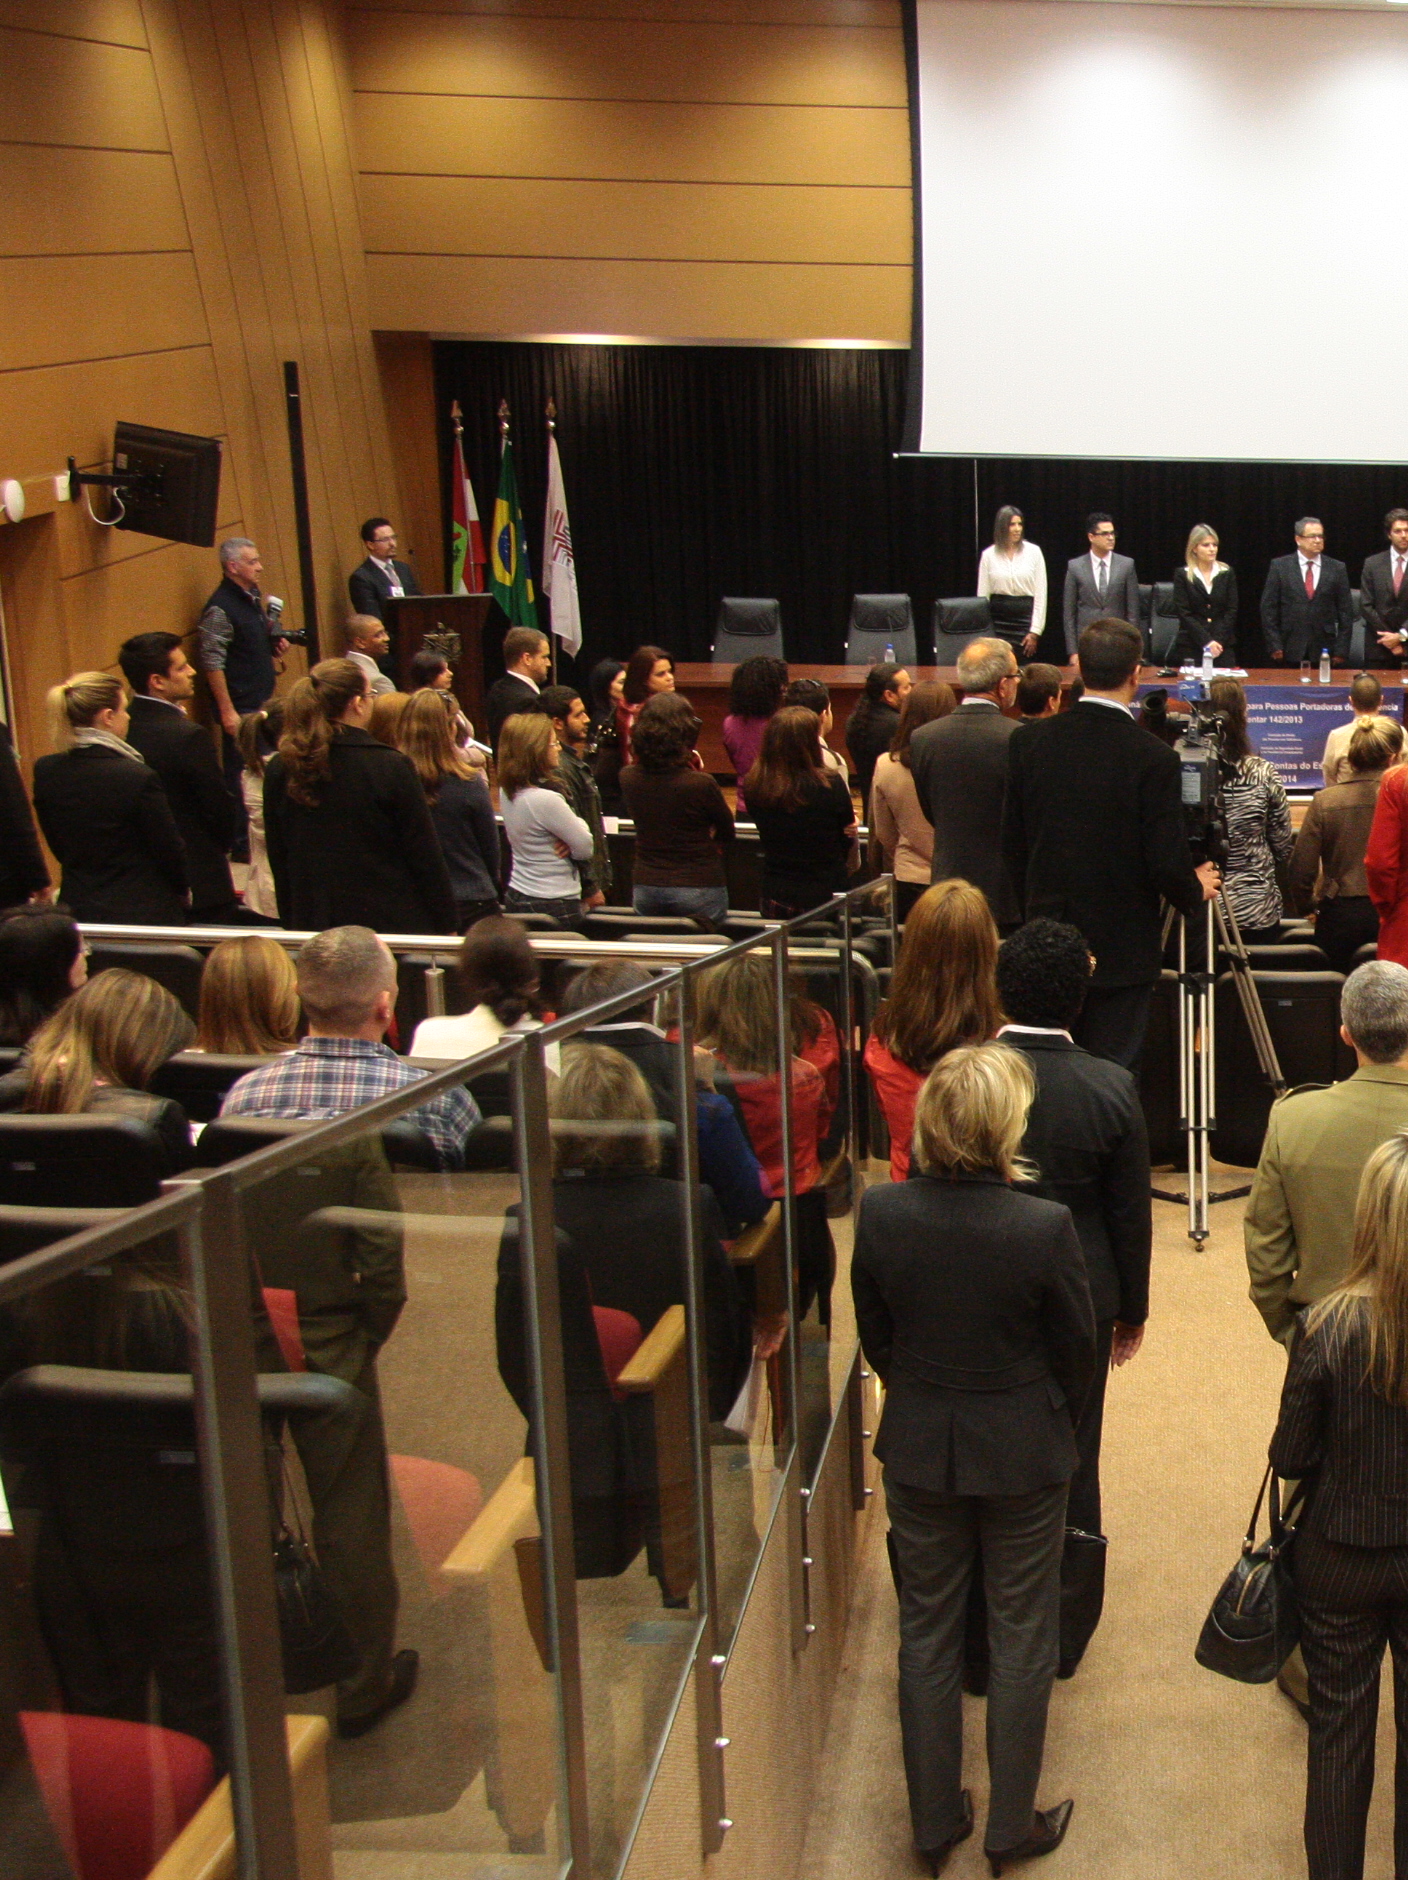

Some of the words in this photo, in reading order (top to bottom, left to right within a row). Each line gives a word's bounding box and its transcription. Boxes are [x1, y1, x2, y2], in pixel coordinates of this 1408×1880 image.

[1264, 702, 1298, 710] Pessoas
[1300, 703, 1342, 711] Portadoras
[1269, 715, 1303, 724] 142/2013
[1274, 762, 1298, 770] ontas
[1300, 761, 1310, 770] do
[1281, 775, 1297, 783] 014
